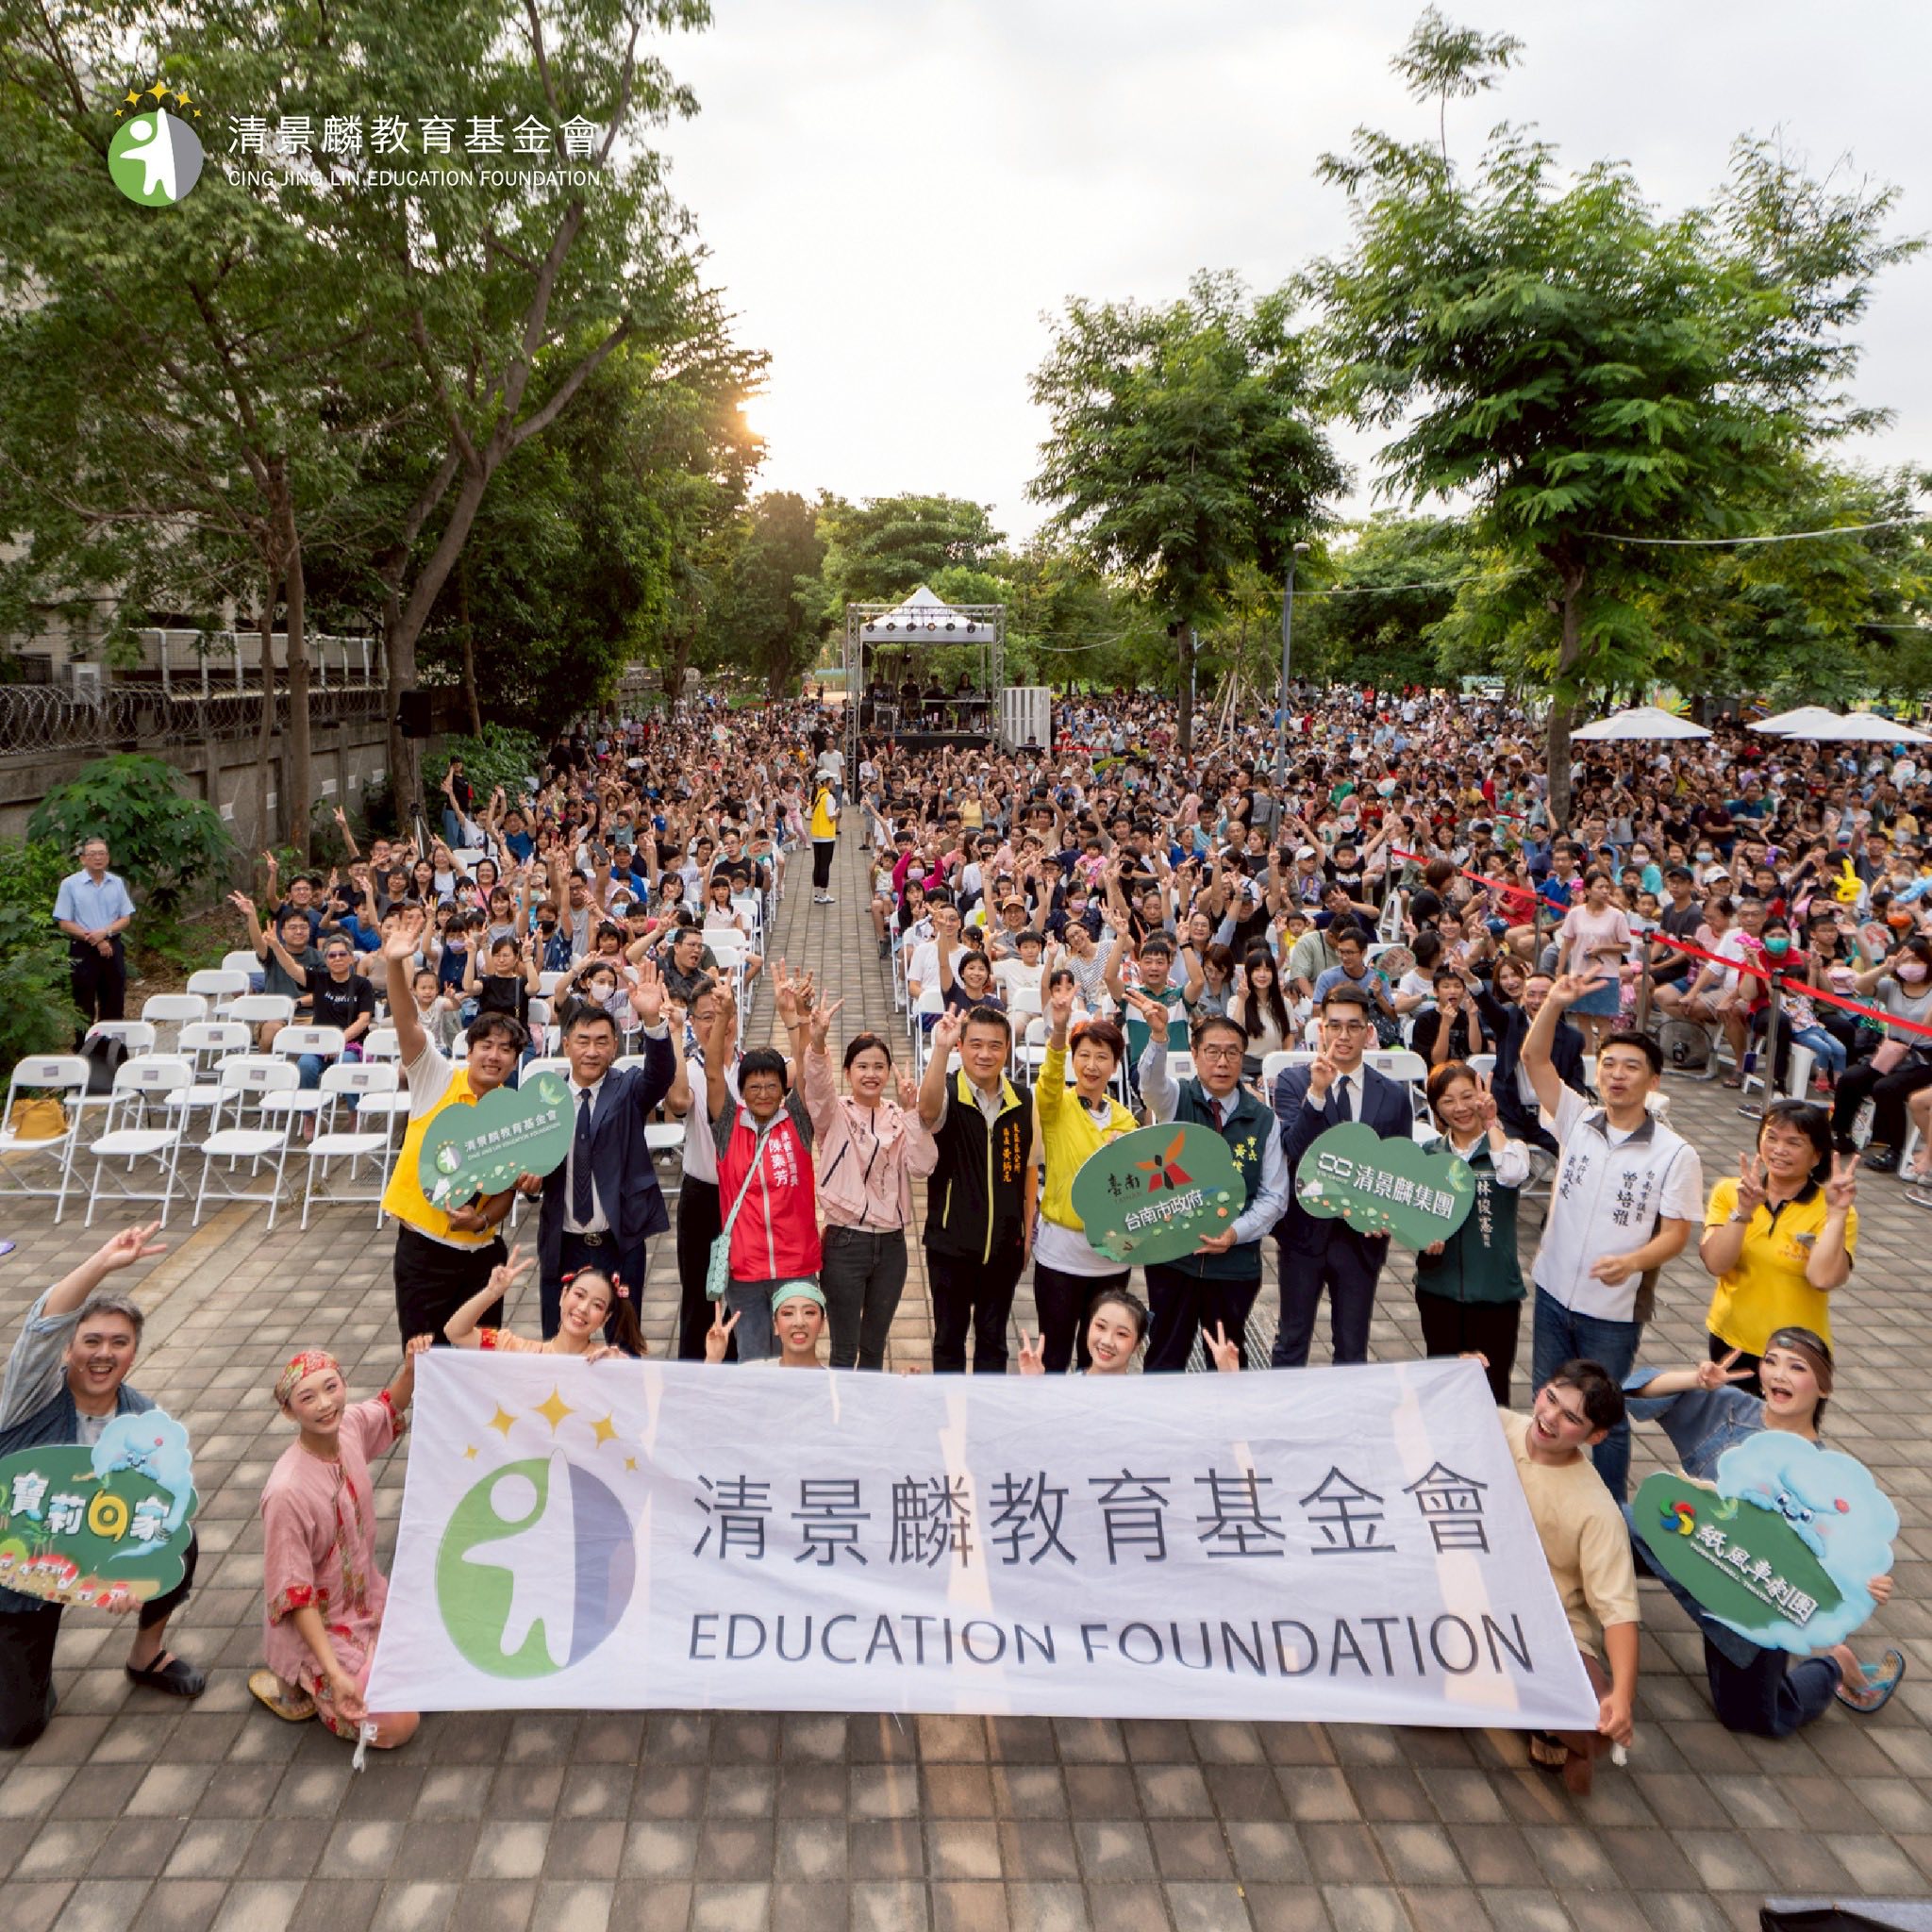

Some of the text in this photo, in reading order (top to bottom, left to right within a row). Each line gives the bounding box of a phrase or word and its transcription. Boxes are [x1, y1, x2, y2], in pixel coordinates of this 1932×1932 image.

[1124, 1189, 1204, 1232] 台南市政府
[1353, 1162, 1456, 1220] 清景麟集團
[691, 1460, 1491, 1569] 清景麟教育基金會
[1695, 1524, 1819, 1623] 紙風車劇團
[689, 1612, 1536, 1679] EDUCATION FOUNDATION
